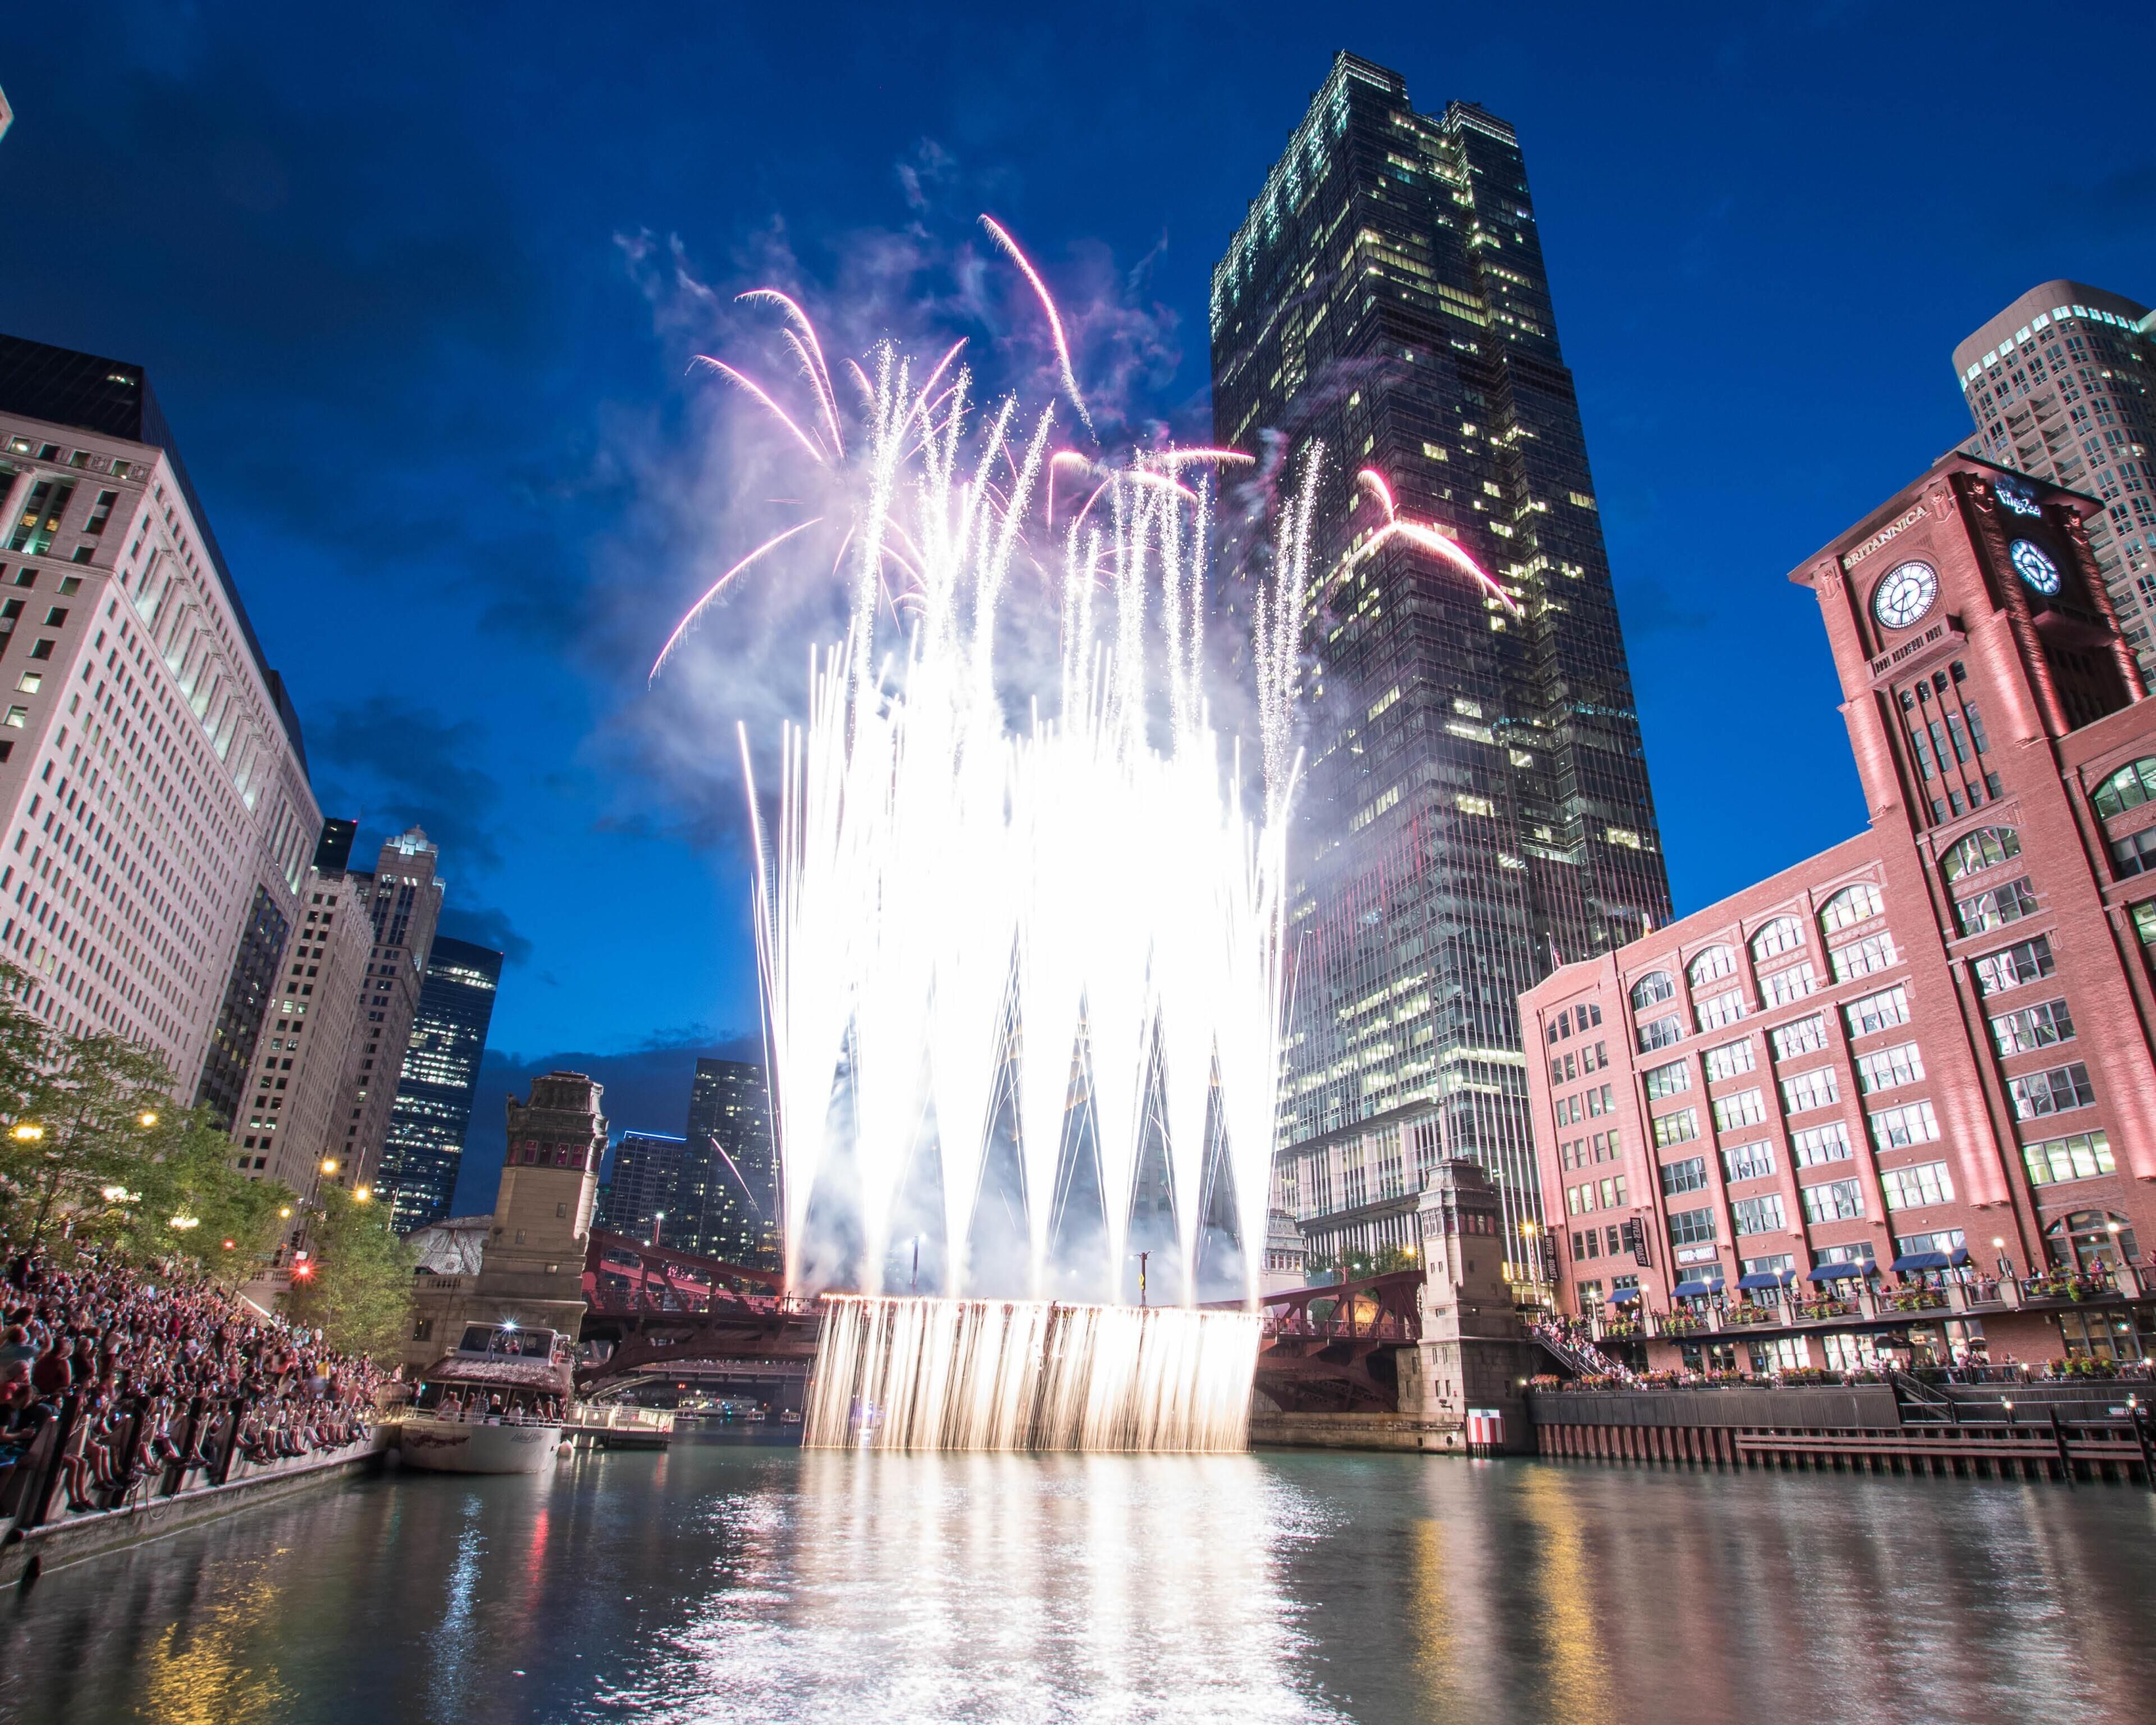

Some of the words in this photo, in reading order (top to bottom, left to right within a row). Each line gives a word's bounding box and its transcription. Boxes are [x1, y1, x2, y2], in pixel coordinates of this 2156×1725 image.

[1843, 506, 1927, 570] BRITANNICA
[1632, 1219, 1641, 1239] RIVER
[1545, 1237, 1554, 1256] RIVER
[1635, 1243, 1646, 1265] ROAST
[1547, 1259, 1557, 1279] ROAST
